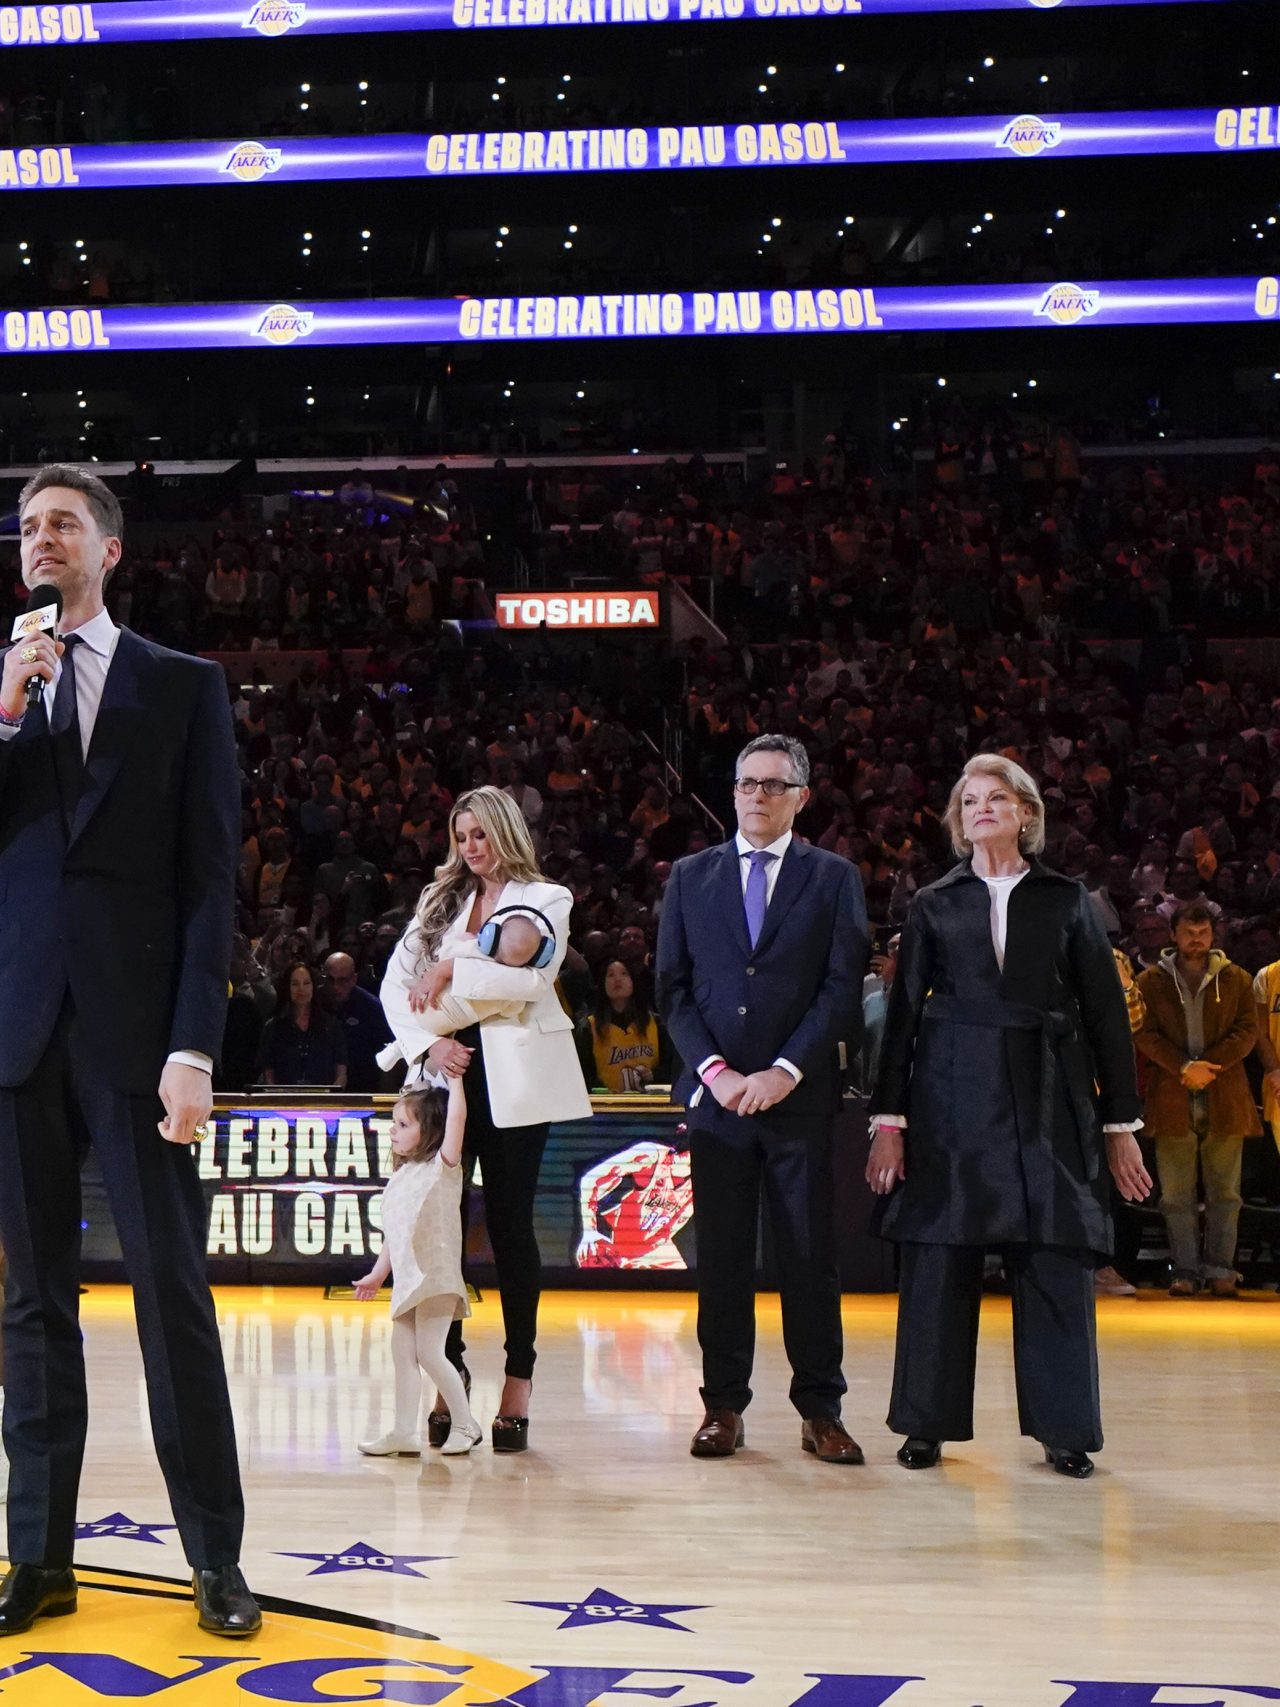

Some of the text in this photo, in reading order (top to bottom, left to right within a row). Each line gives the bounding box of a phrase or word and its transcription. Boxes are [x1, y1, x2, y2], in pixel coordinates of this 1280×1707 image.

[0, 5, 99, 43] GASOL
[426, 122, 846, 173] CELEBRATING PAU GASOL
[5, 309, 110, 349] GASOL
[459, 288, 883, 338] CELEBRATING PAU GASOL
[500, 598, 655, 624] TOSHIBA
[607, 1045, 654, 1066] LAKERS
[206, 1193, 274, 1255] AU
[325, 1555, 394, 1567] '80
[567, 1604, 649, 1618] '82
